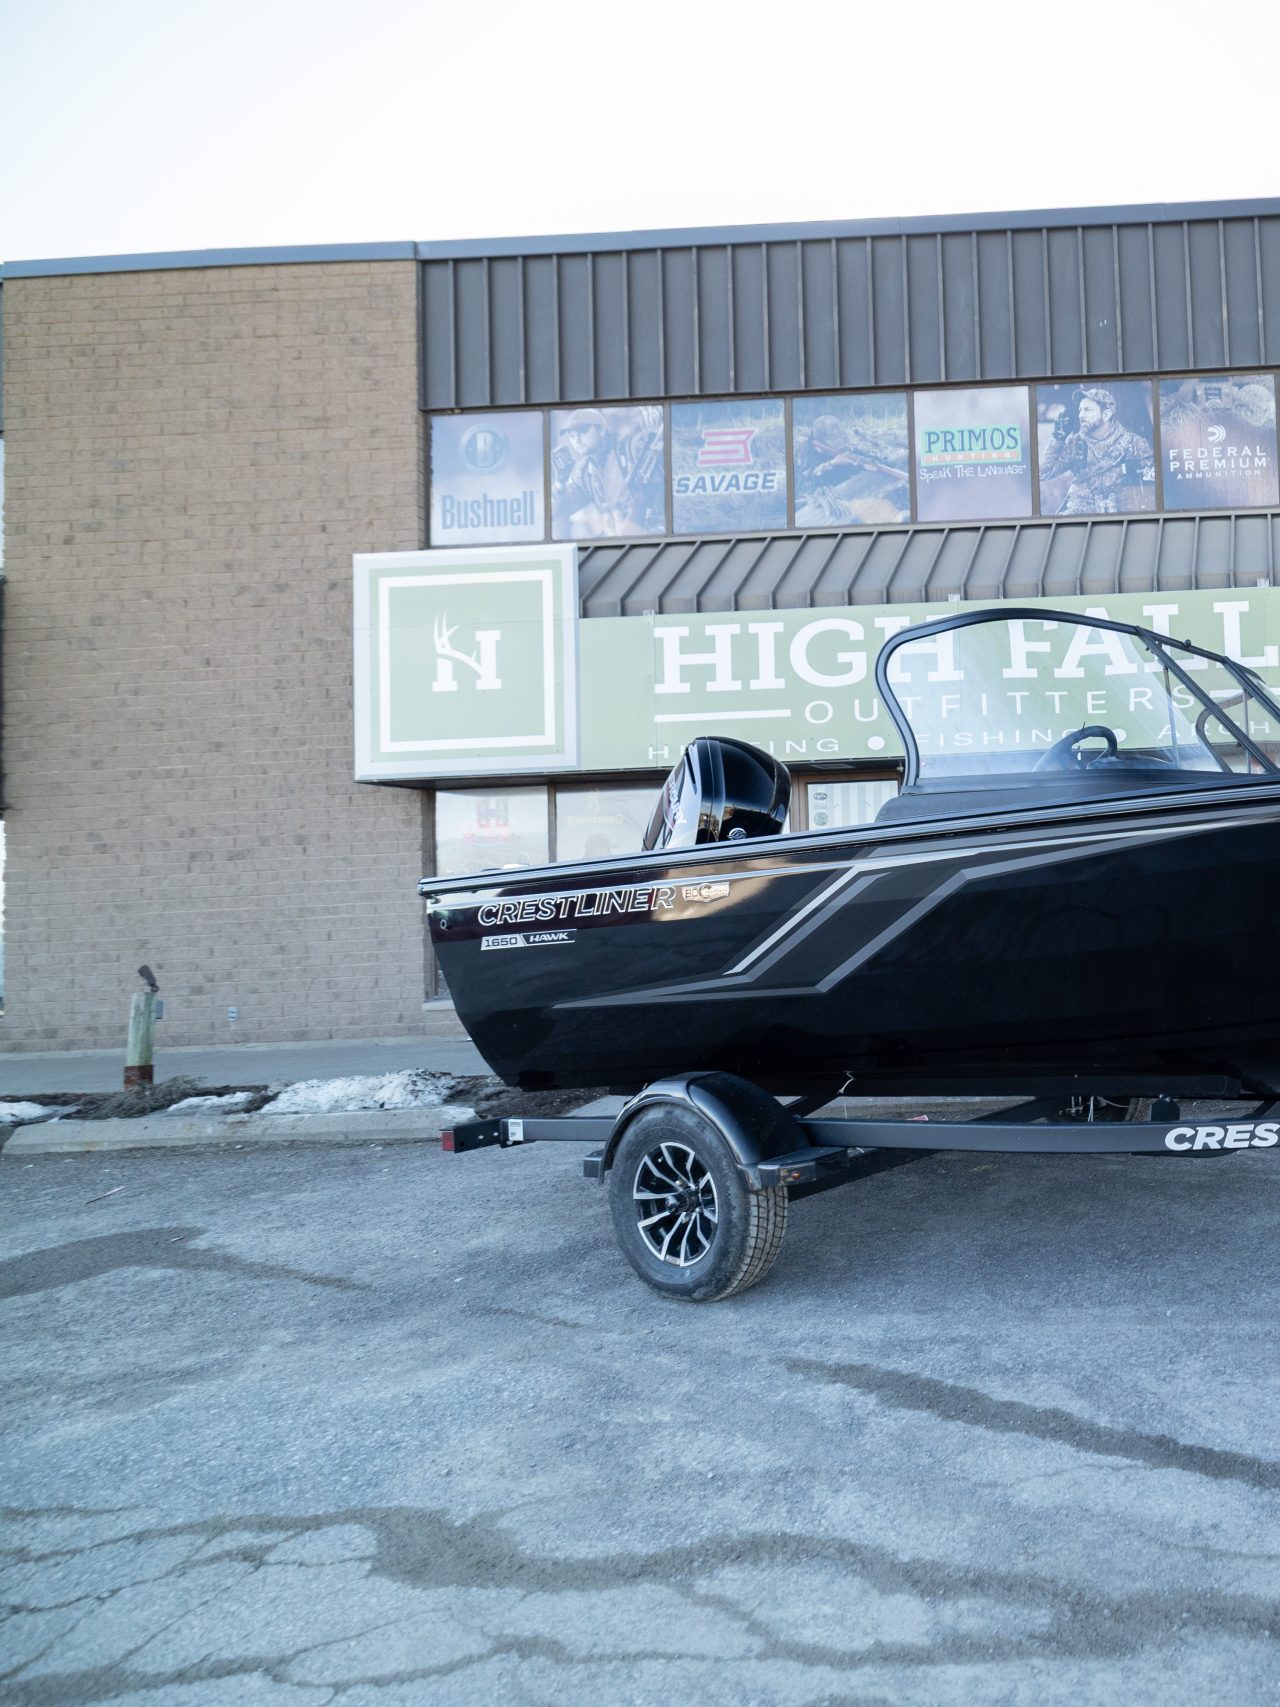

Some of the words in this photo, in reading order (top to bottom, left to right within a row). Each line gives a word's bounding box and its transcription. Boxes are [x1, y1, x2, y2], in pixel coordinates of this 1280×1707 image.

[924, 427, 1018, 453] PRIMOS
[1169, 445, 1266, 460] FEDERAL
[1169, 457, 1267, 472] PREMIUM
[1176, 469, 1261, 481] AMMUNITION
[674, 471, 777, 494] SAVAGE
[441, 490, 535, 530] Bushnell
[653, 614, 965, 695] HIGH
[804, 684, 1196, 724] OUTFITTERS
[648, 738, 839, 760] HING
[478, 886, 677, 926] CRESTLINER
[485, 936, 518, 948] 1650
[529, 932, 569, 943] HAWK
